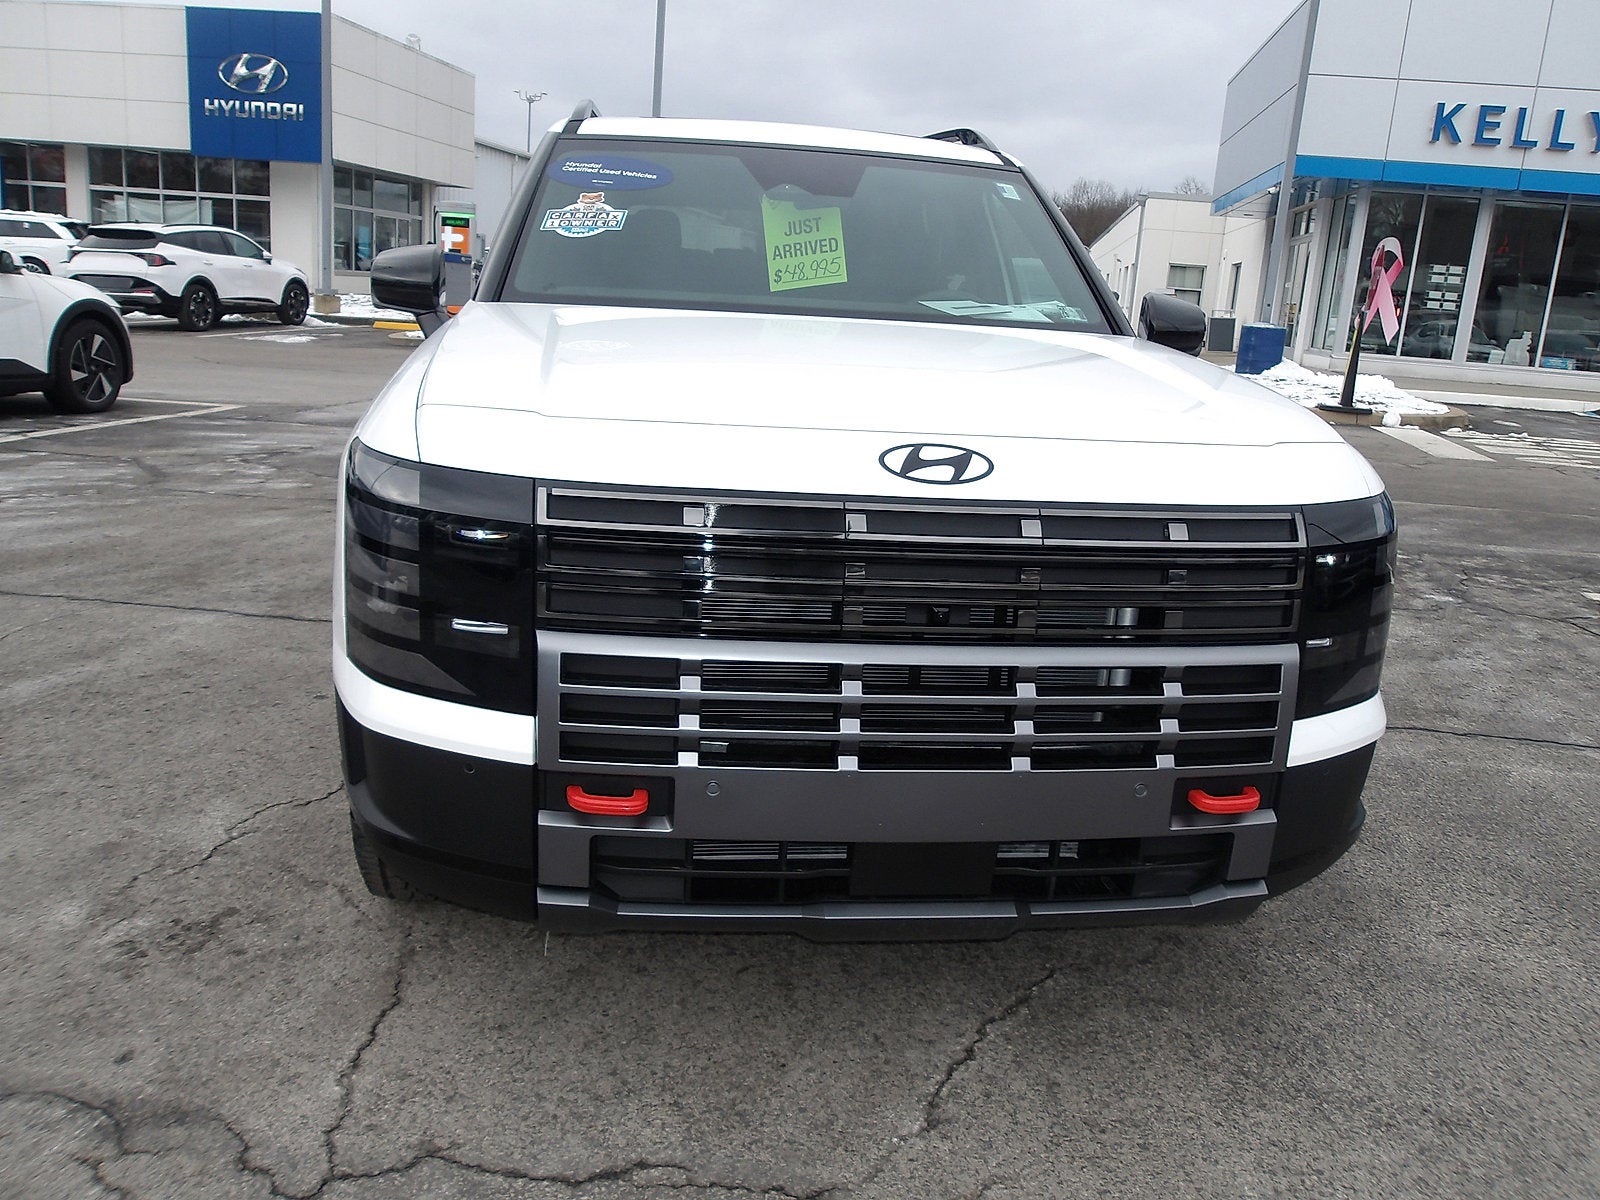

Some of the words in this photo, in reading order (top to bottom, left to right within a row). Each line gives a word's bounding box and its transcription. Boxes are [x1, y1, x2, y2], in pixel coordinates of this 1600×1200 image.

[204, 98, 304, 121] HYUNDAI
[622, 170, 657, 179] Vehicles
[550, 211, 621, 220] CARFAX
[784, 217, 821, 236] JUST
[773, 237, 839, 261] ARRIVED
